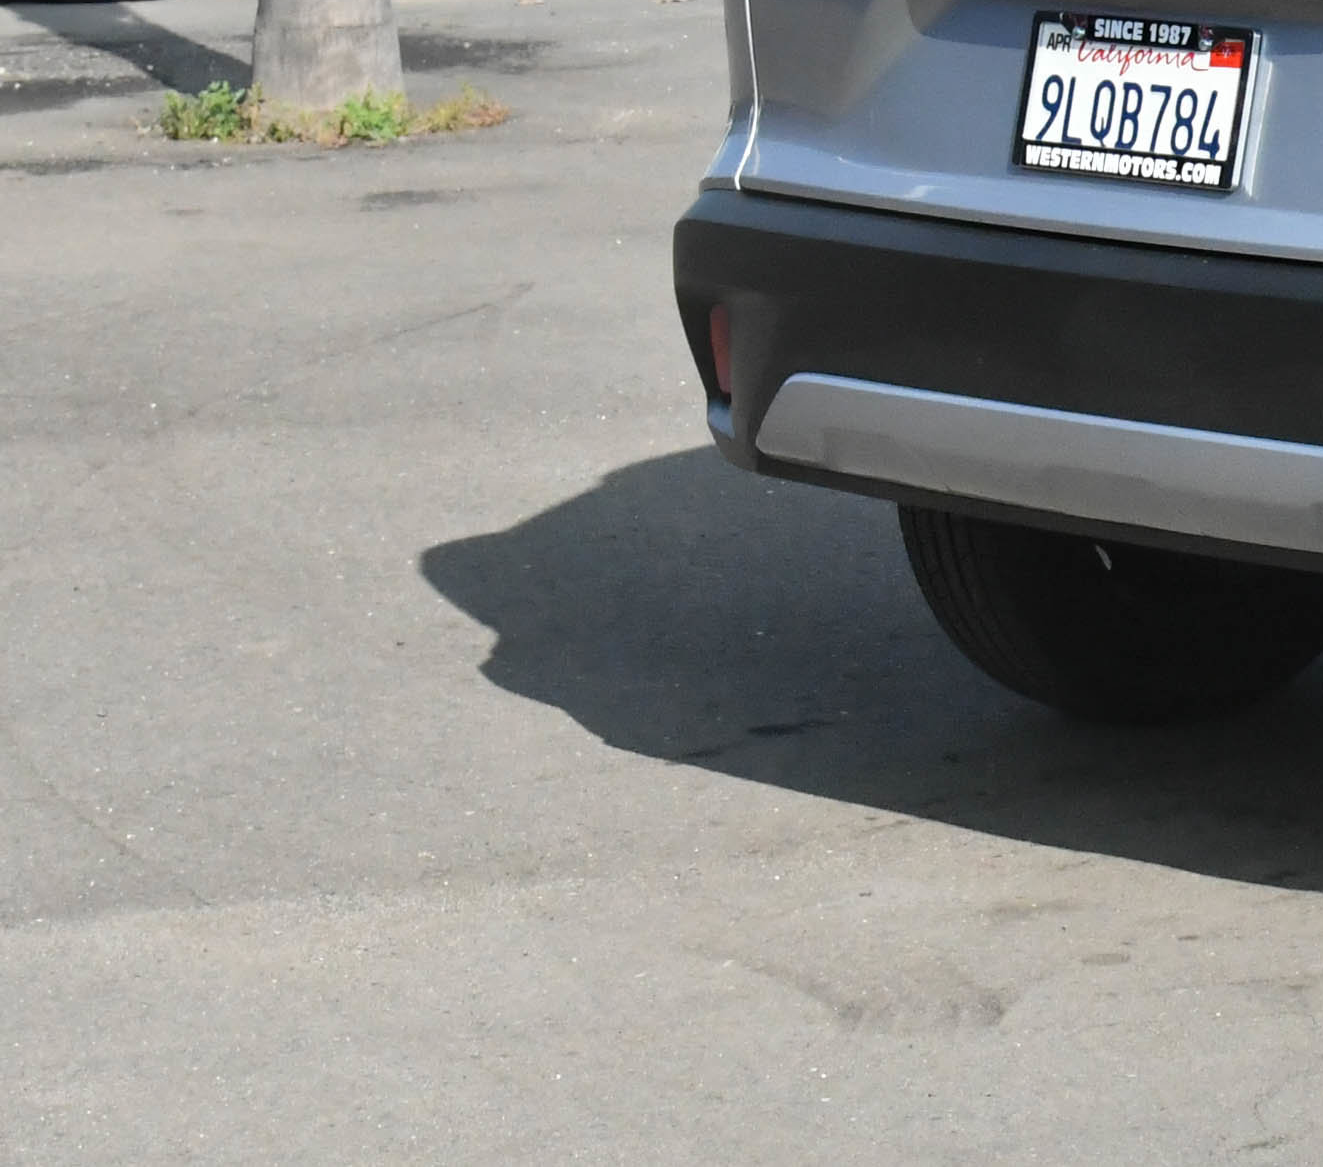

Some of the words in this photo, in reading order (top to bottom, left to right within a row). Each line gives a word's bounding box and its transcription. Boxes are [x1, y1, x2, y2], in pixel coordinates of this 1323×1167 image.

[1046, 32, 1071, 53] APR
[1094, 18, 1144, 41] SINCE
[1149, 23, 1192, 46] 1987
[1077, 40, 1208, 76] California
[1036, 74, 1220, 159] 9LQB784
[1025, 144, 1222, 185] WESTERNMOTORS.COM
